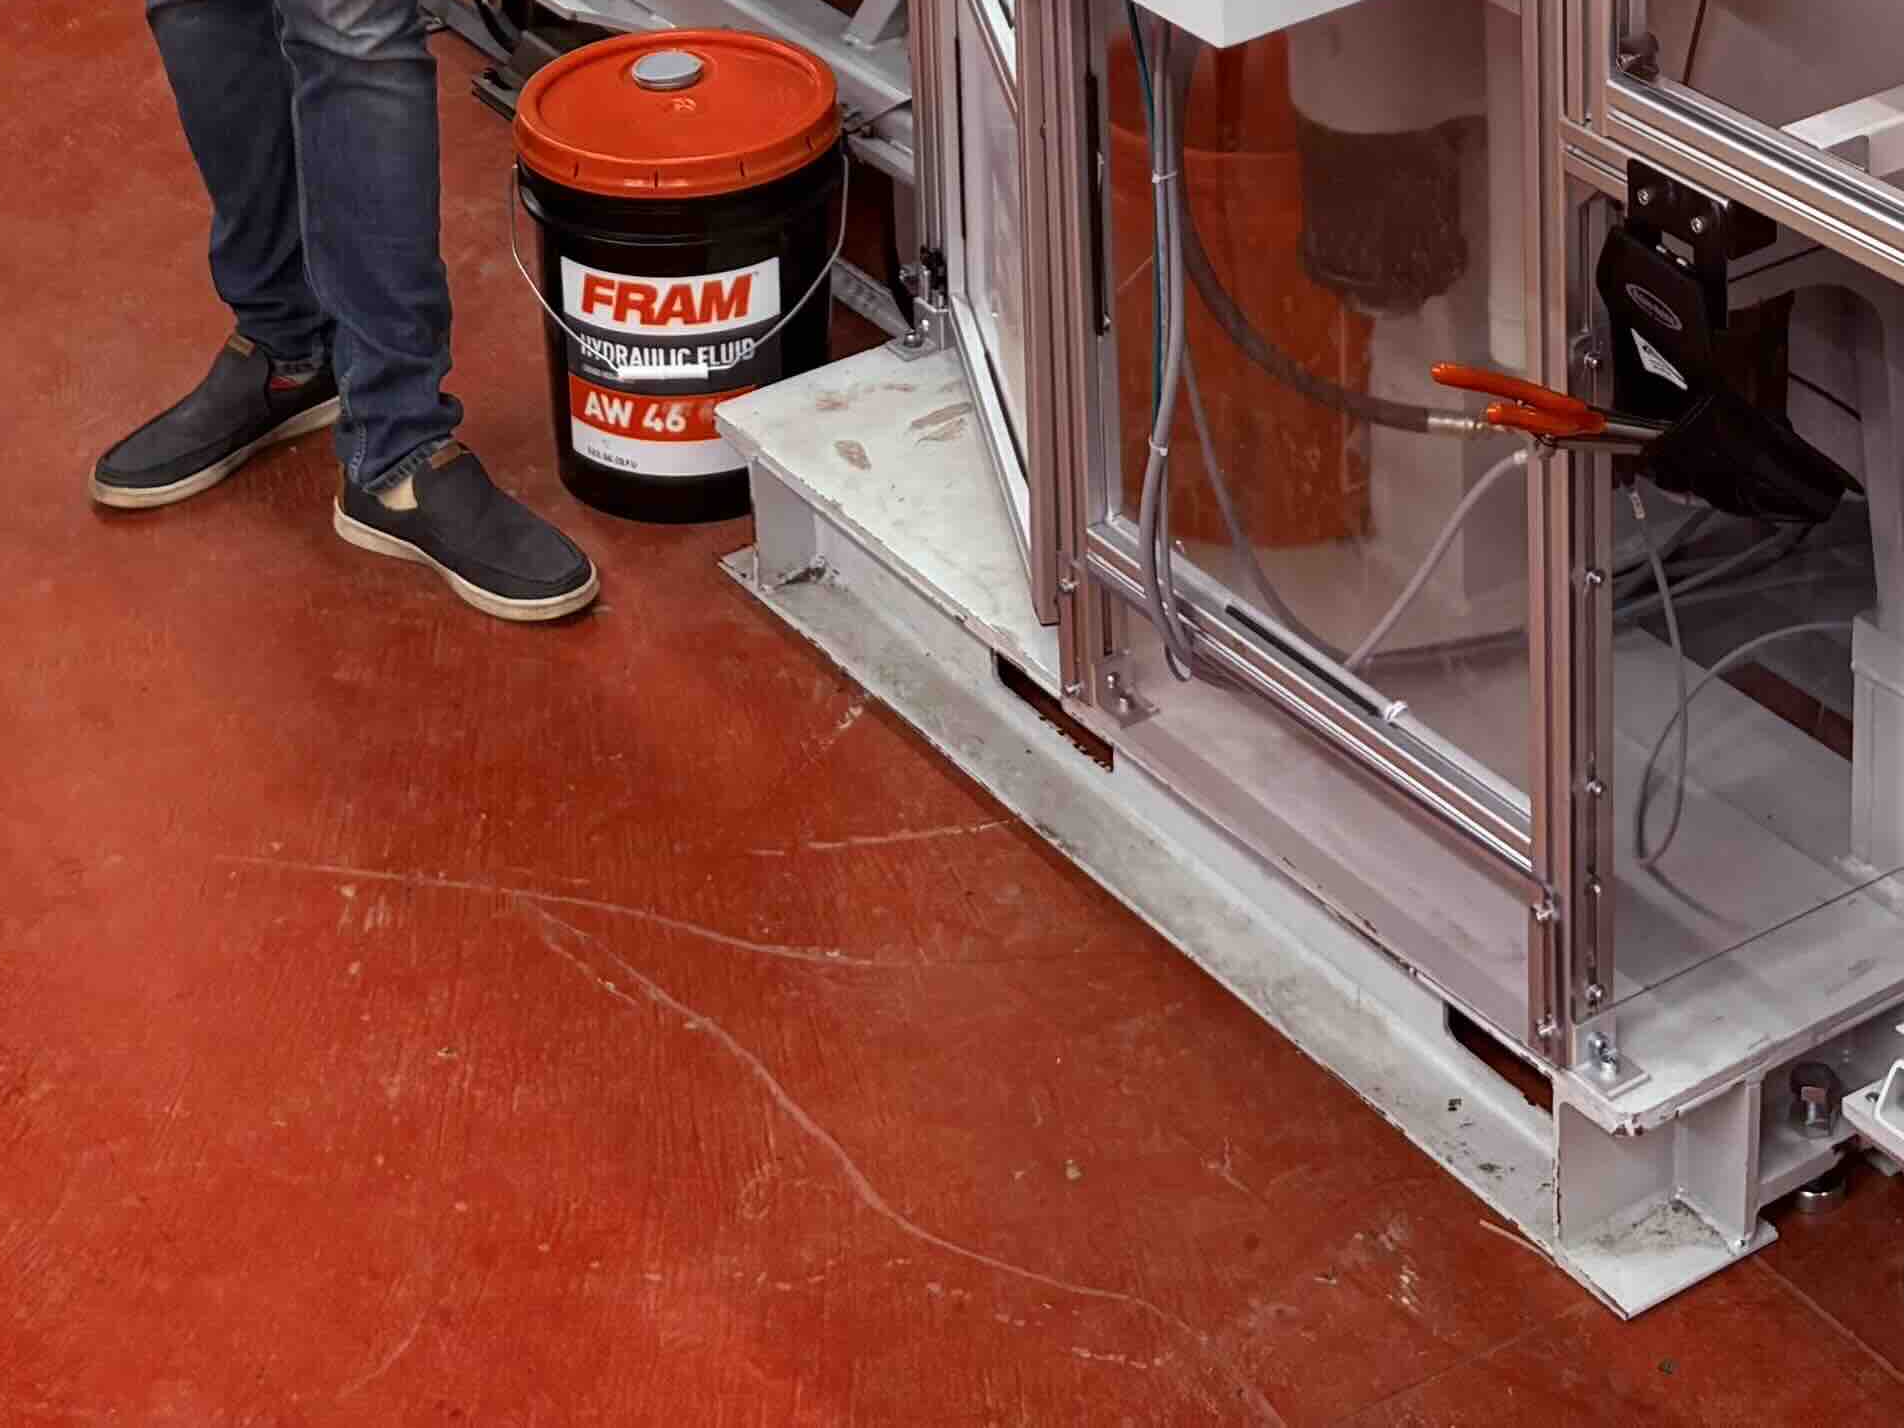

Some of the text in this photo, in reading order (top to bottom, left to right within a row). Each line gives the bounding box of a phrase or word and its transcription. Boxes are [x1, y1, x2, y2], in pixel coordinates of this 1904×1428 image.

[581, 272, 753, 327] FRAM
[580, 332, 756, 368] HYDRAULIC FLUID
[585, 391, 687, 432] AW 46
